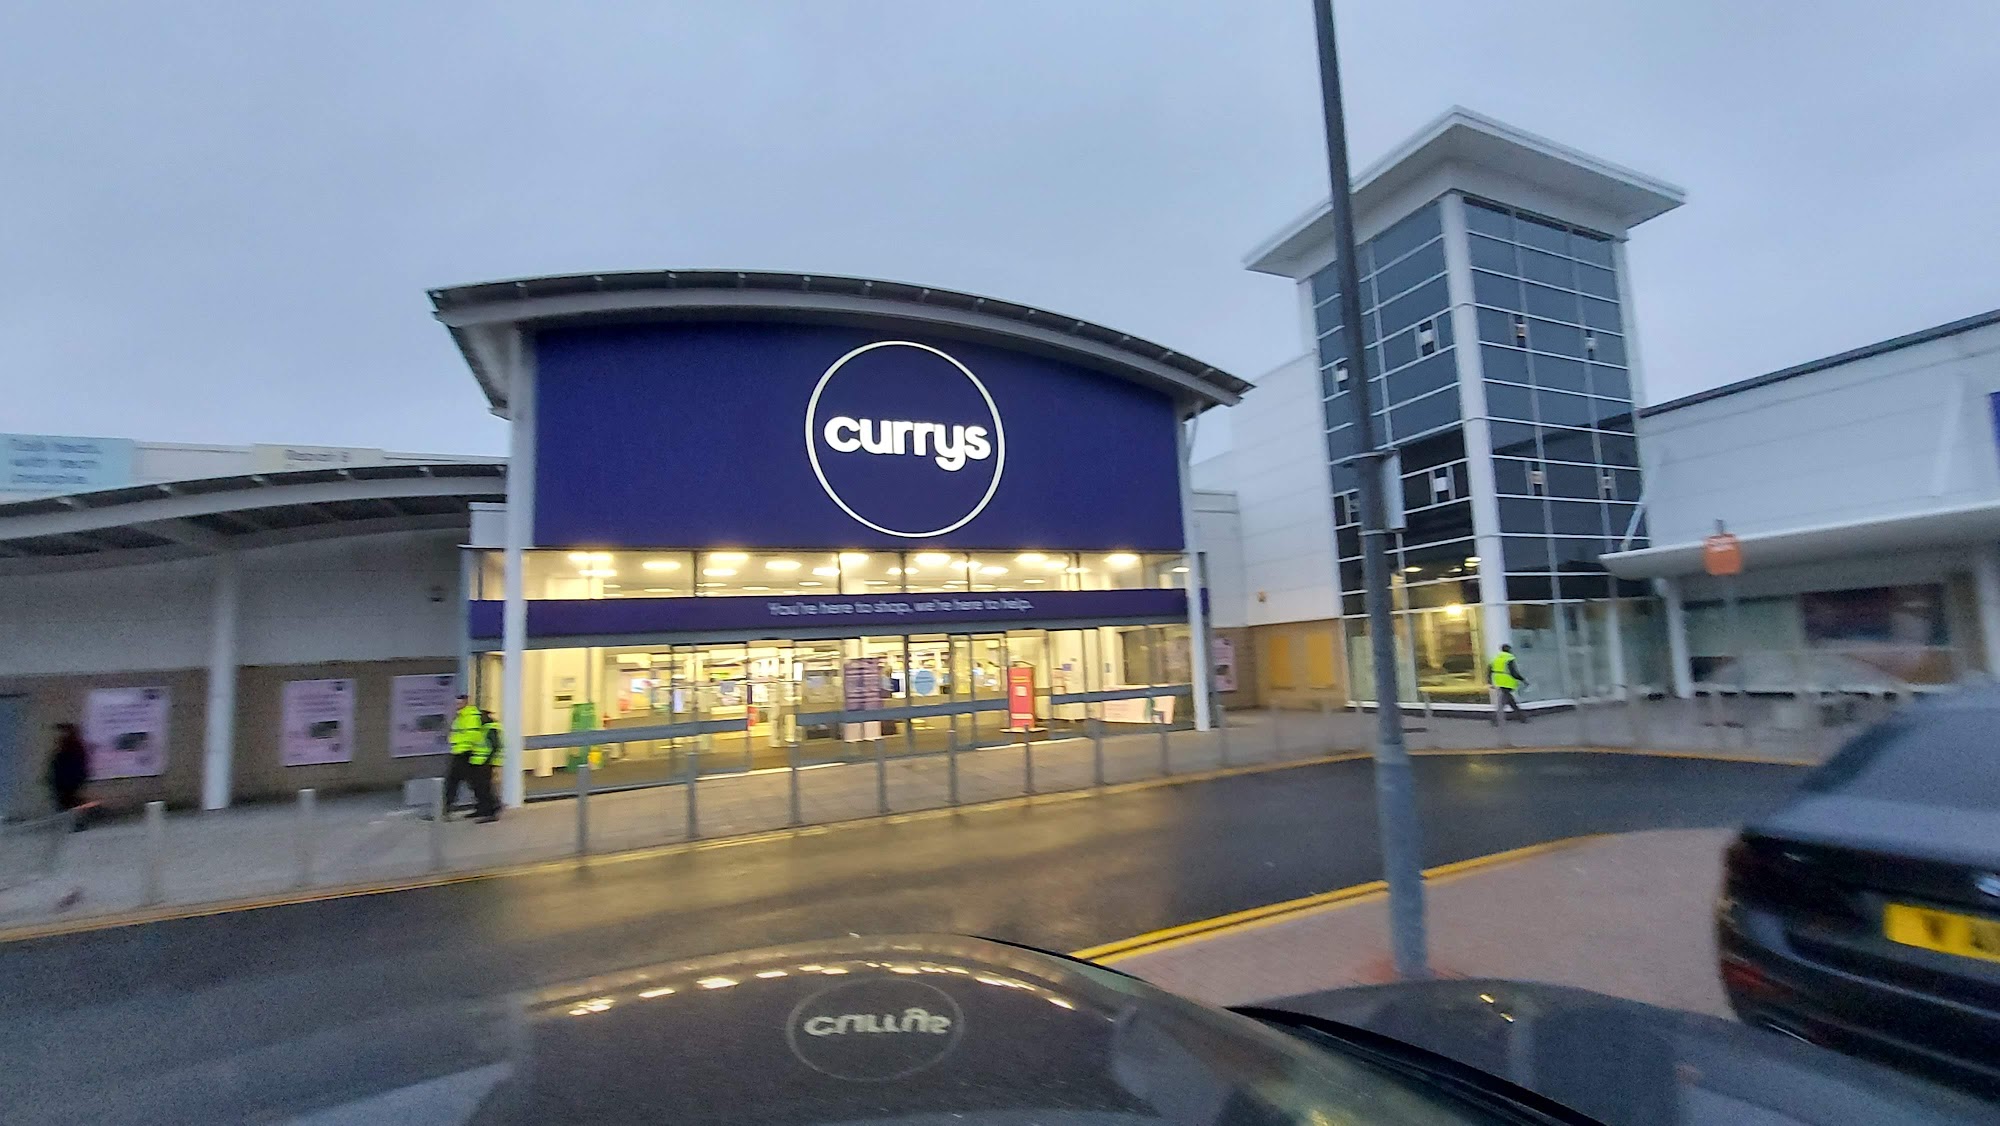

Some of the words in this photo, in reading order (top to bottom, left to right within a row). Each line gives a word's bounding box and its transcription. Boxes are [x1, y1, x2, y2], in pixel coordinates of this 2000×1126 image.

[824, 416, 991, 471] currys
[819, 601, 854, 614] here
[854, 601, 873, 613] to
[952, 599, 984, 611] here
[983, 599, 1000, 610] to
